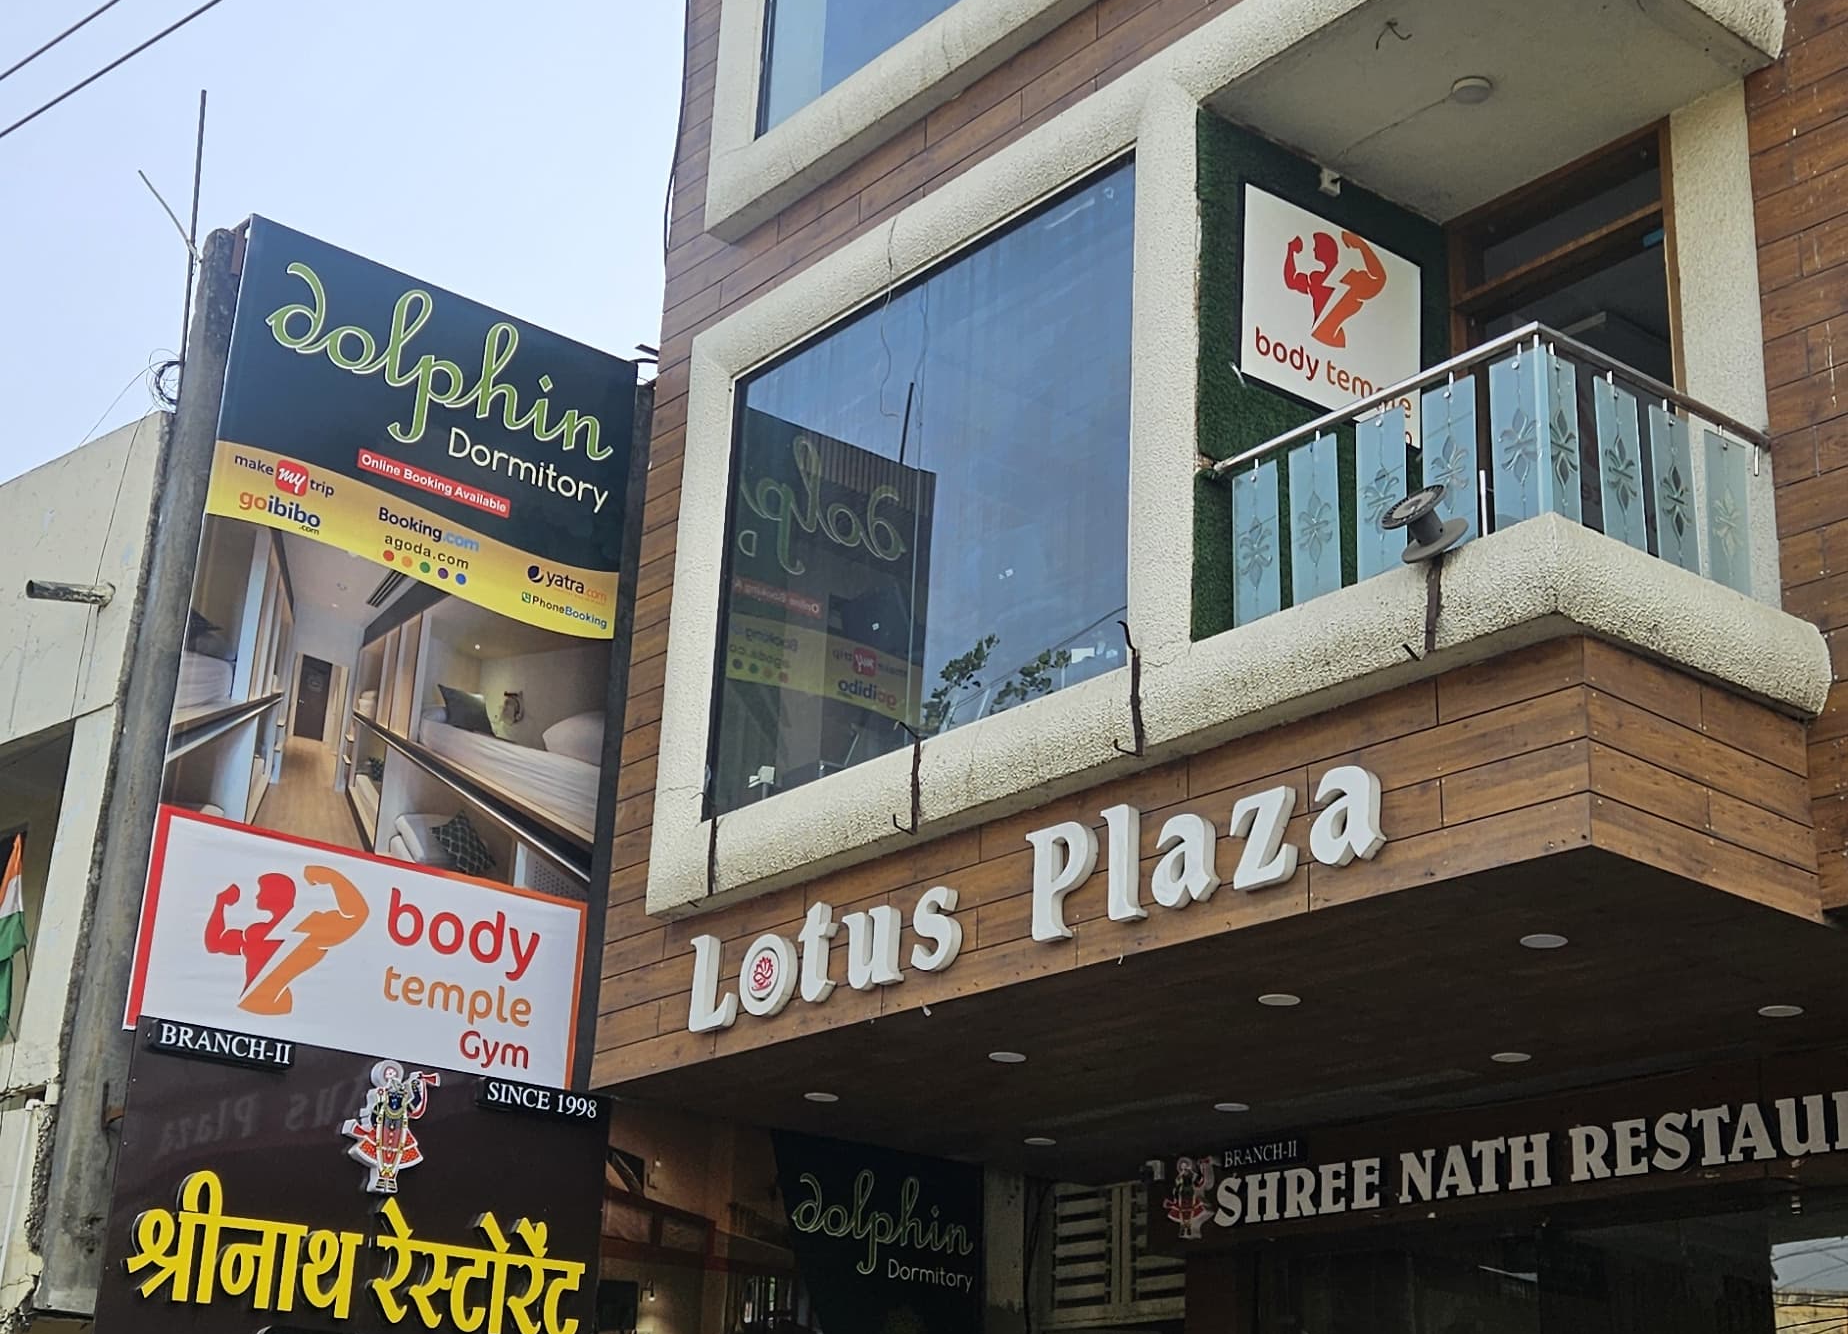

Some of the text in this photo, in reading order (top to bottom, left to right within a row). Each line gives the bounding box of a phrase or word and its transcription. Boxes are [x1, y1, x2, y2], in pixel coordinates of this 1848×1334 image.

[265, 261, 614, 461] dolphin
[1255, 326, 1319, 381] body
[234, 455, 335, 498] make my trip
[361, 454, 507, 513] Online Booking Available
[448, 427, 609, 514] Dormitory
[239, 491, 321, 527] goibibo
[379, 507, 480, 552] Booking.com
[384, 535, 469, 570] agoda.com
[688, 765, 1388, 1034] Lotus Plaza
[387, 887, 541, 982] body
[383, 966, 532, 1028] temple
[159, 1023, 294, 1066] BRANCH-II
[459, 1030, 530, 1071] Gym
[487, 1082, 598, 1120] SINCE 1998
[1213, 1157, 1380, 1227] SHREE
[1397, 1131, 1552, 1205] NATH
[1224, 1140, 1297, 1168] BRANCH-II
[127, 1170, 364, 1319] श्रीनाथ
[792, 1169, 974, 1275] dolphin
[888, 1259, 974, 1293] Dormitory
